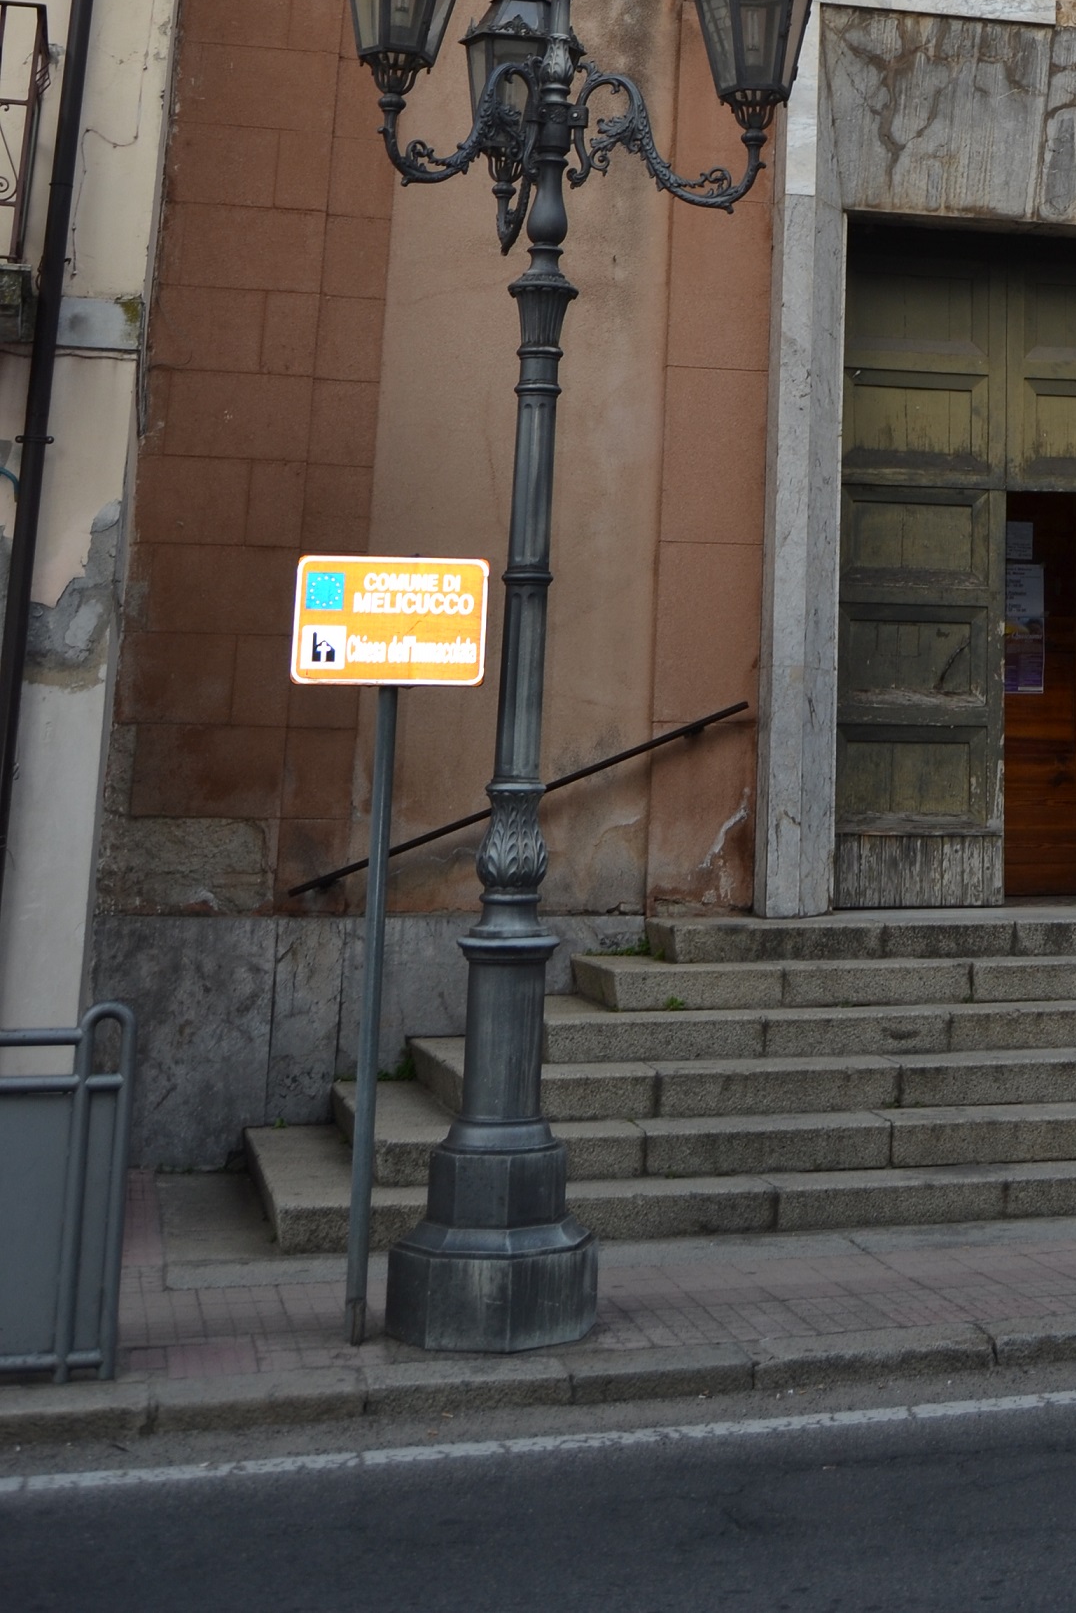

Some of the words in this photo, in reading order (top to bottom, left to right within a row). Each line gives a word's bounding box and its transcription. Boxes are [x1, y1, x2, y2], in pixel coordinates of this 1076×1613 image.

[364, 573, 439, 591] COMUNE
[443, 574, 461, 592] DI
[353, 592, 475, 615] MELICUCCO
